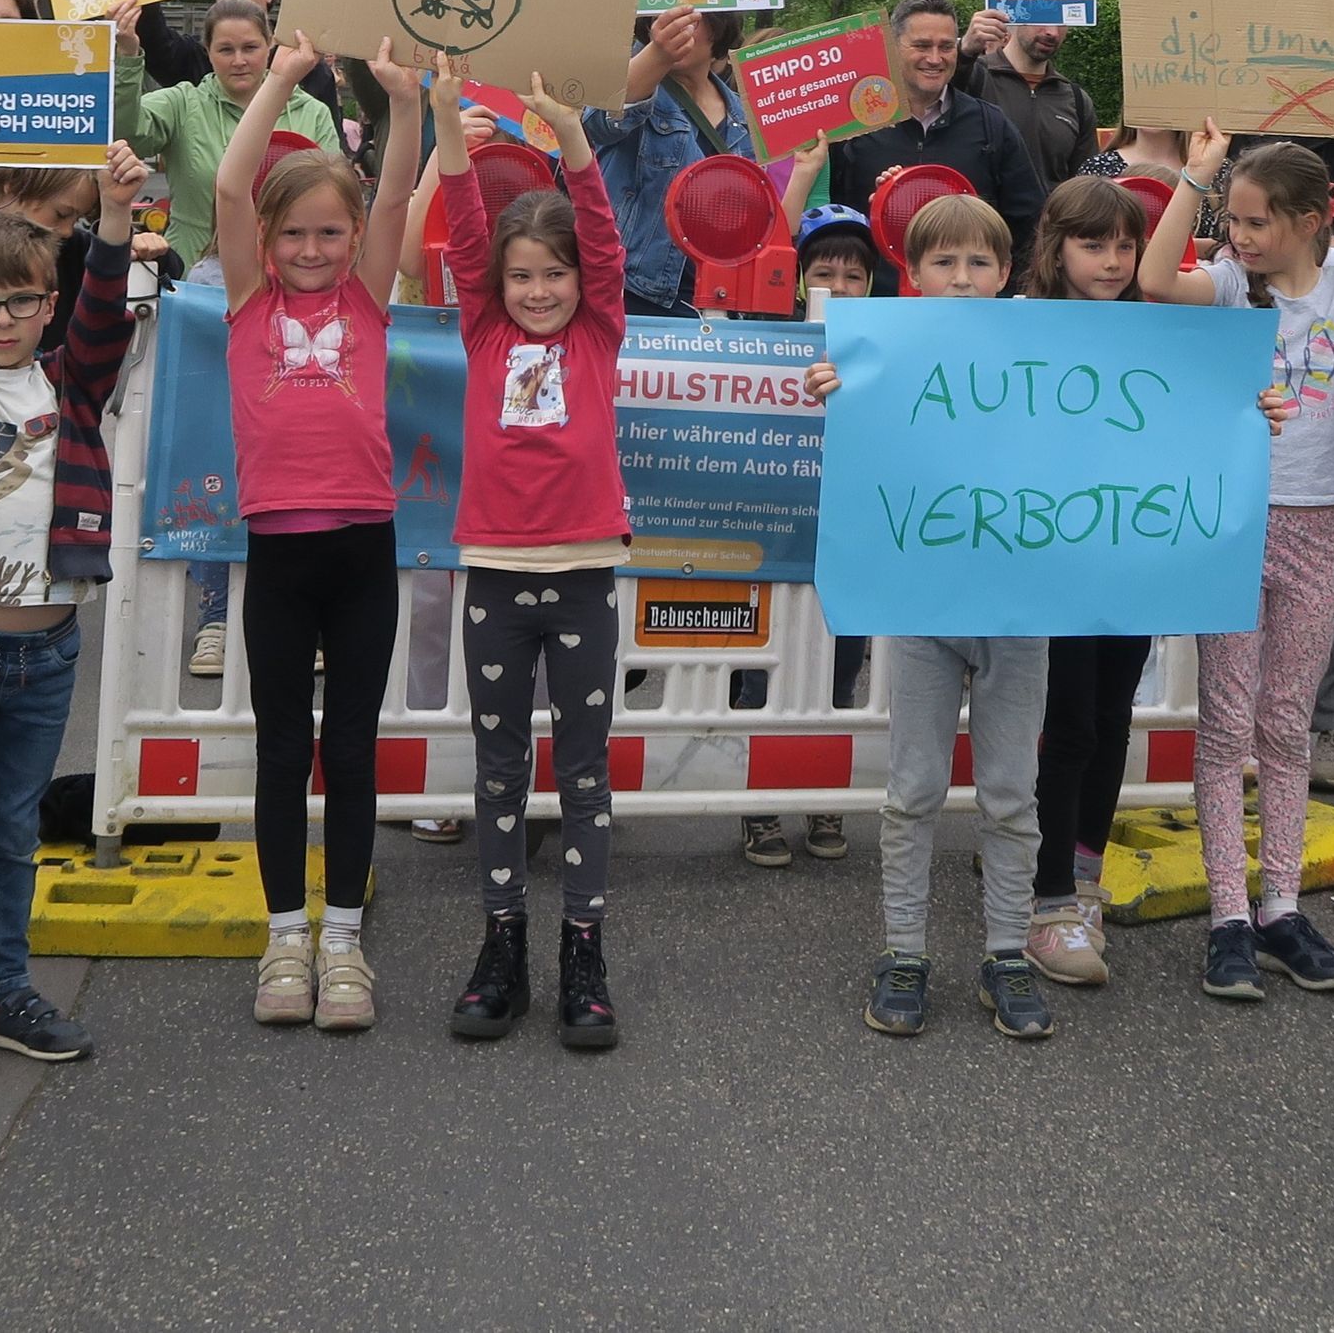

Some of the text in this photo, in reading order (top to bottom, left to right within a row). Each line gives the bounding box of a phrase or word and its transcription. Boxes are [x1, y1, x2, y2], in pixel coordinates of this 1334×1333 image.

[1161, 11, 1229, 73] die
[750, 46, 842, 87] TEMPO 30
[757, 70, 857, 108] auf der gesamten
[20, 92, 96, 113] sichere
[761, 94, 840, 126] Rochusstraße
[31, 115, 95, 134] Kleine
[638, 333, 723, 353] befindet
[728, 337, 767, 355] sich
[773, 340, 815, 358] eine
[292, 379, 306, 387] TO
[617, 369, 822, 407] HULSTRASS
[909, 360, 1171, 432] AUTOS
[630, 423, 667, 441] hier
[673, 426, 757, 445] während
[762, 429, 796, 447] der
[617, 451, 821, 477] icht mit dem Auto fäh
[638, 496, 661, 507] alle
[664, 497, 705, 510] Kinder
[708, 499, 732, 512] und
[735, 501, 789, 515] Familien
[877, 473, 1223, 554] VERBOTEN
[167, 530, 211, 542] KIDICAL
[647, 517, 669, 527] von
[672, 514, 696, 527] und
[699, 519, 718, 528] zur
[722, 520, 764, 532] Schule
[767, 522, 796, 534] sind.
[180, 541, 207, 552] MASS
[703, 551, 718, 559] zur
[720, 551, 751, 562] Schule
[650, 606, 750, 628] Debuschewitz
